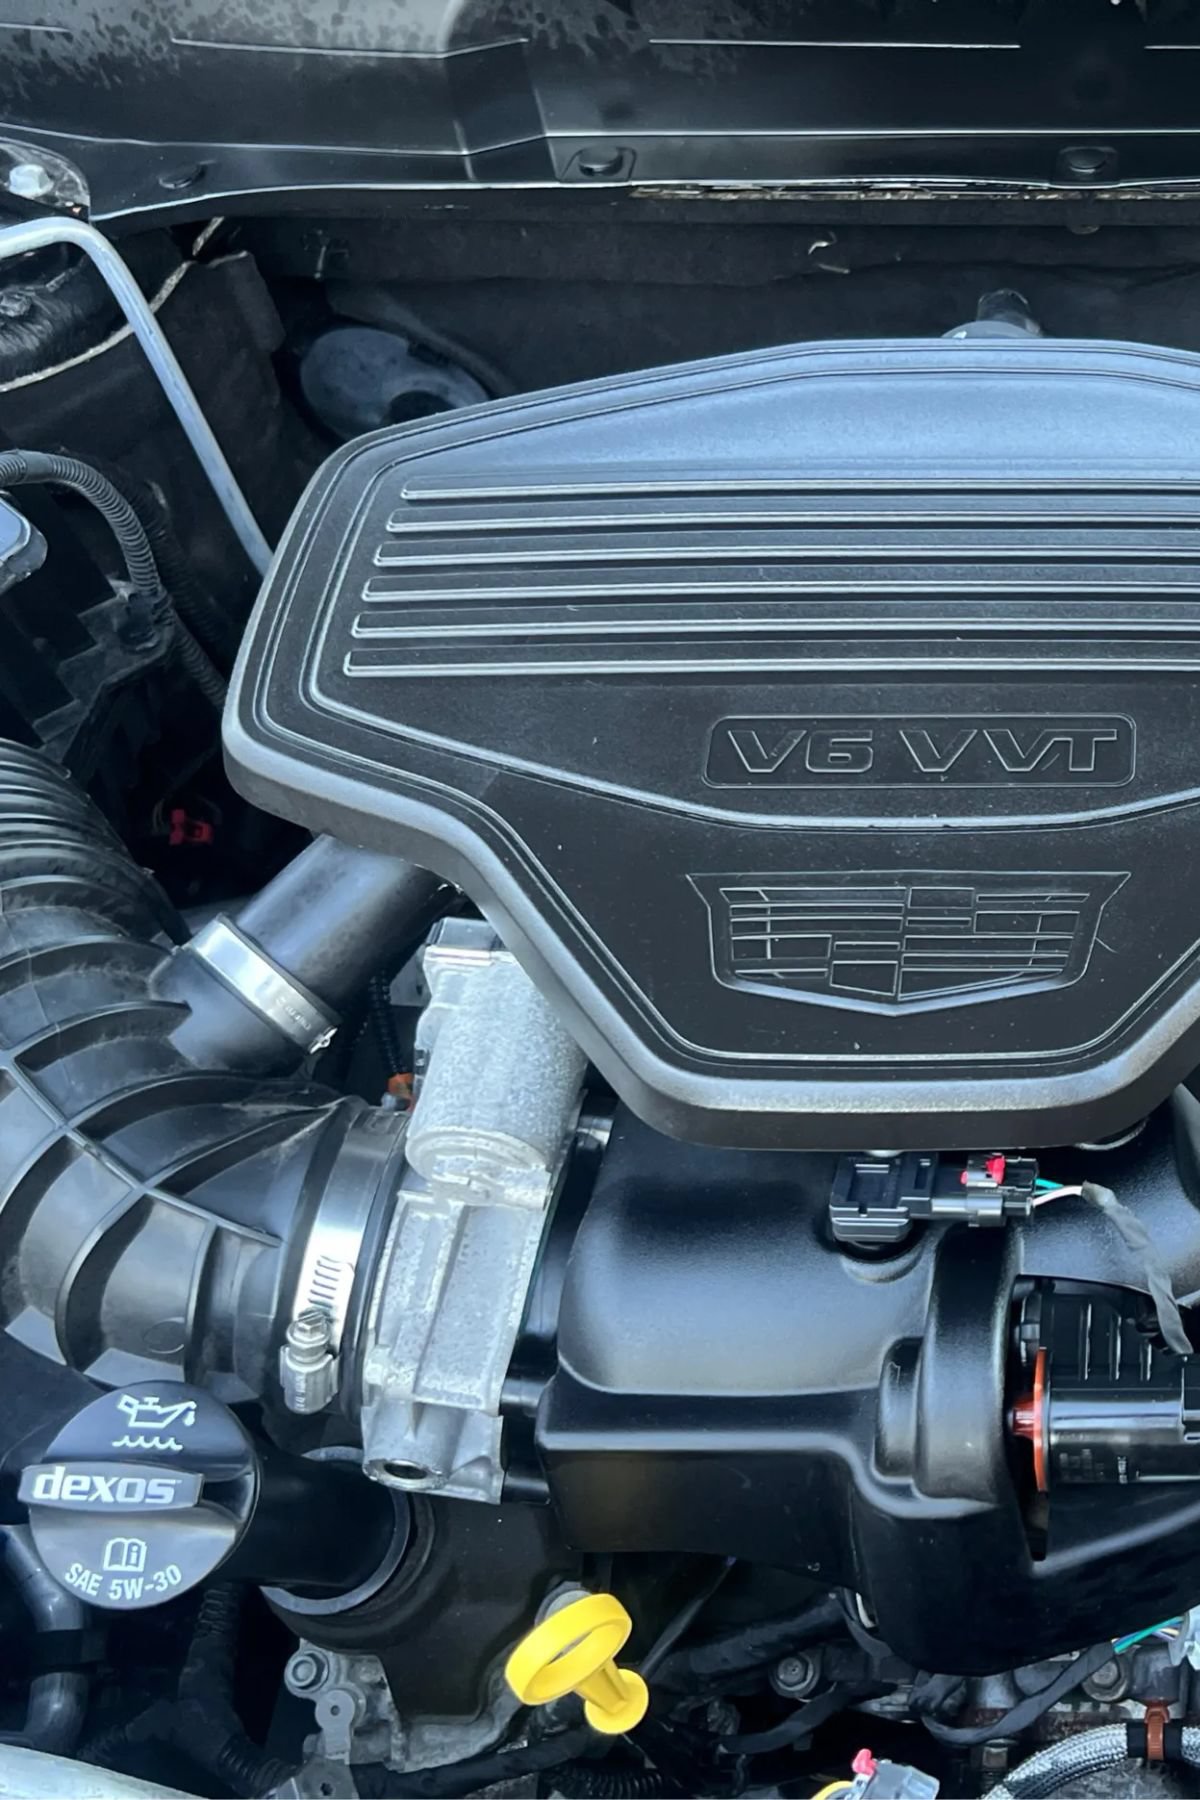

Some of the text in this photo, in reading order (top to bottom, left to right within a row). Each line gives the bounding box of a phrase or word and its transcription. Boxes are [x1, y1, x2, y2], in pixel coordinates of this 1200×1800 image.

[728, 728, 1118, 773] V6 VVT
[32, 1466, 176, 1505] dexos
[64, 1562, 183, 1601] SAE 5W-30
